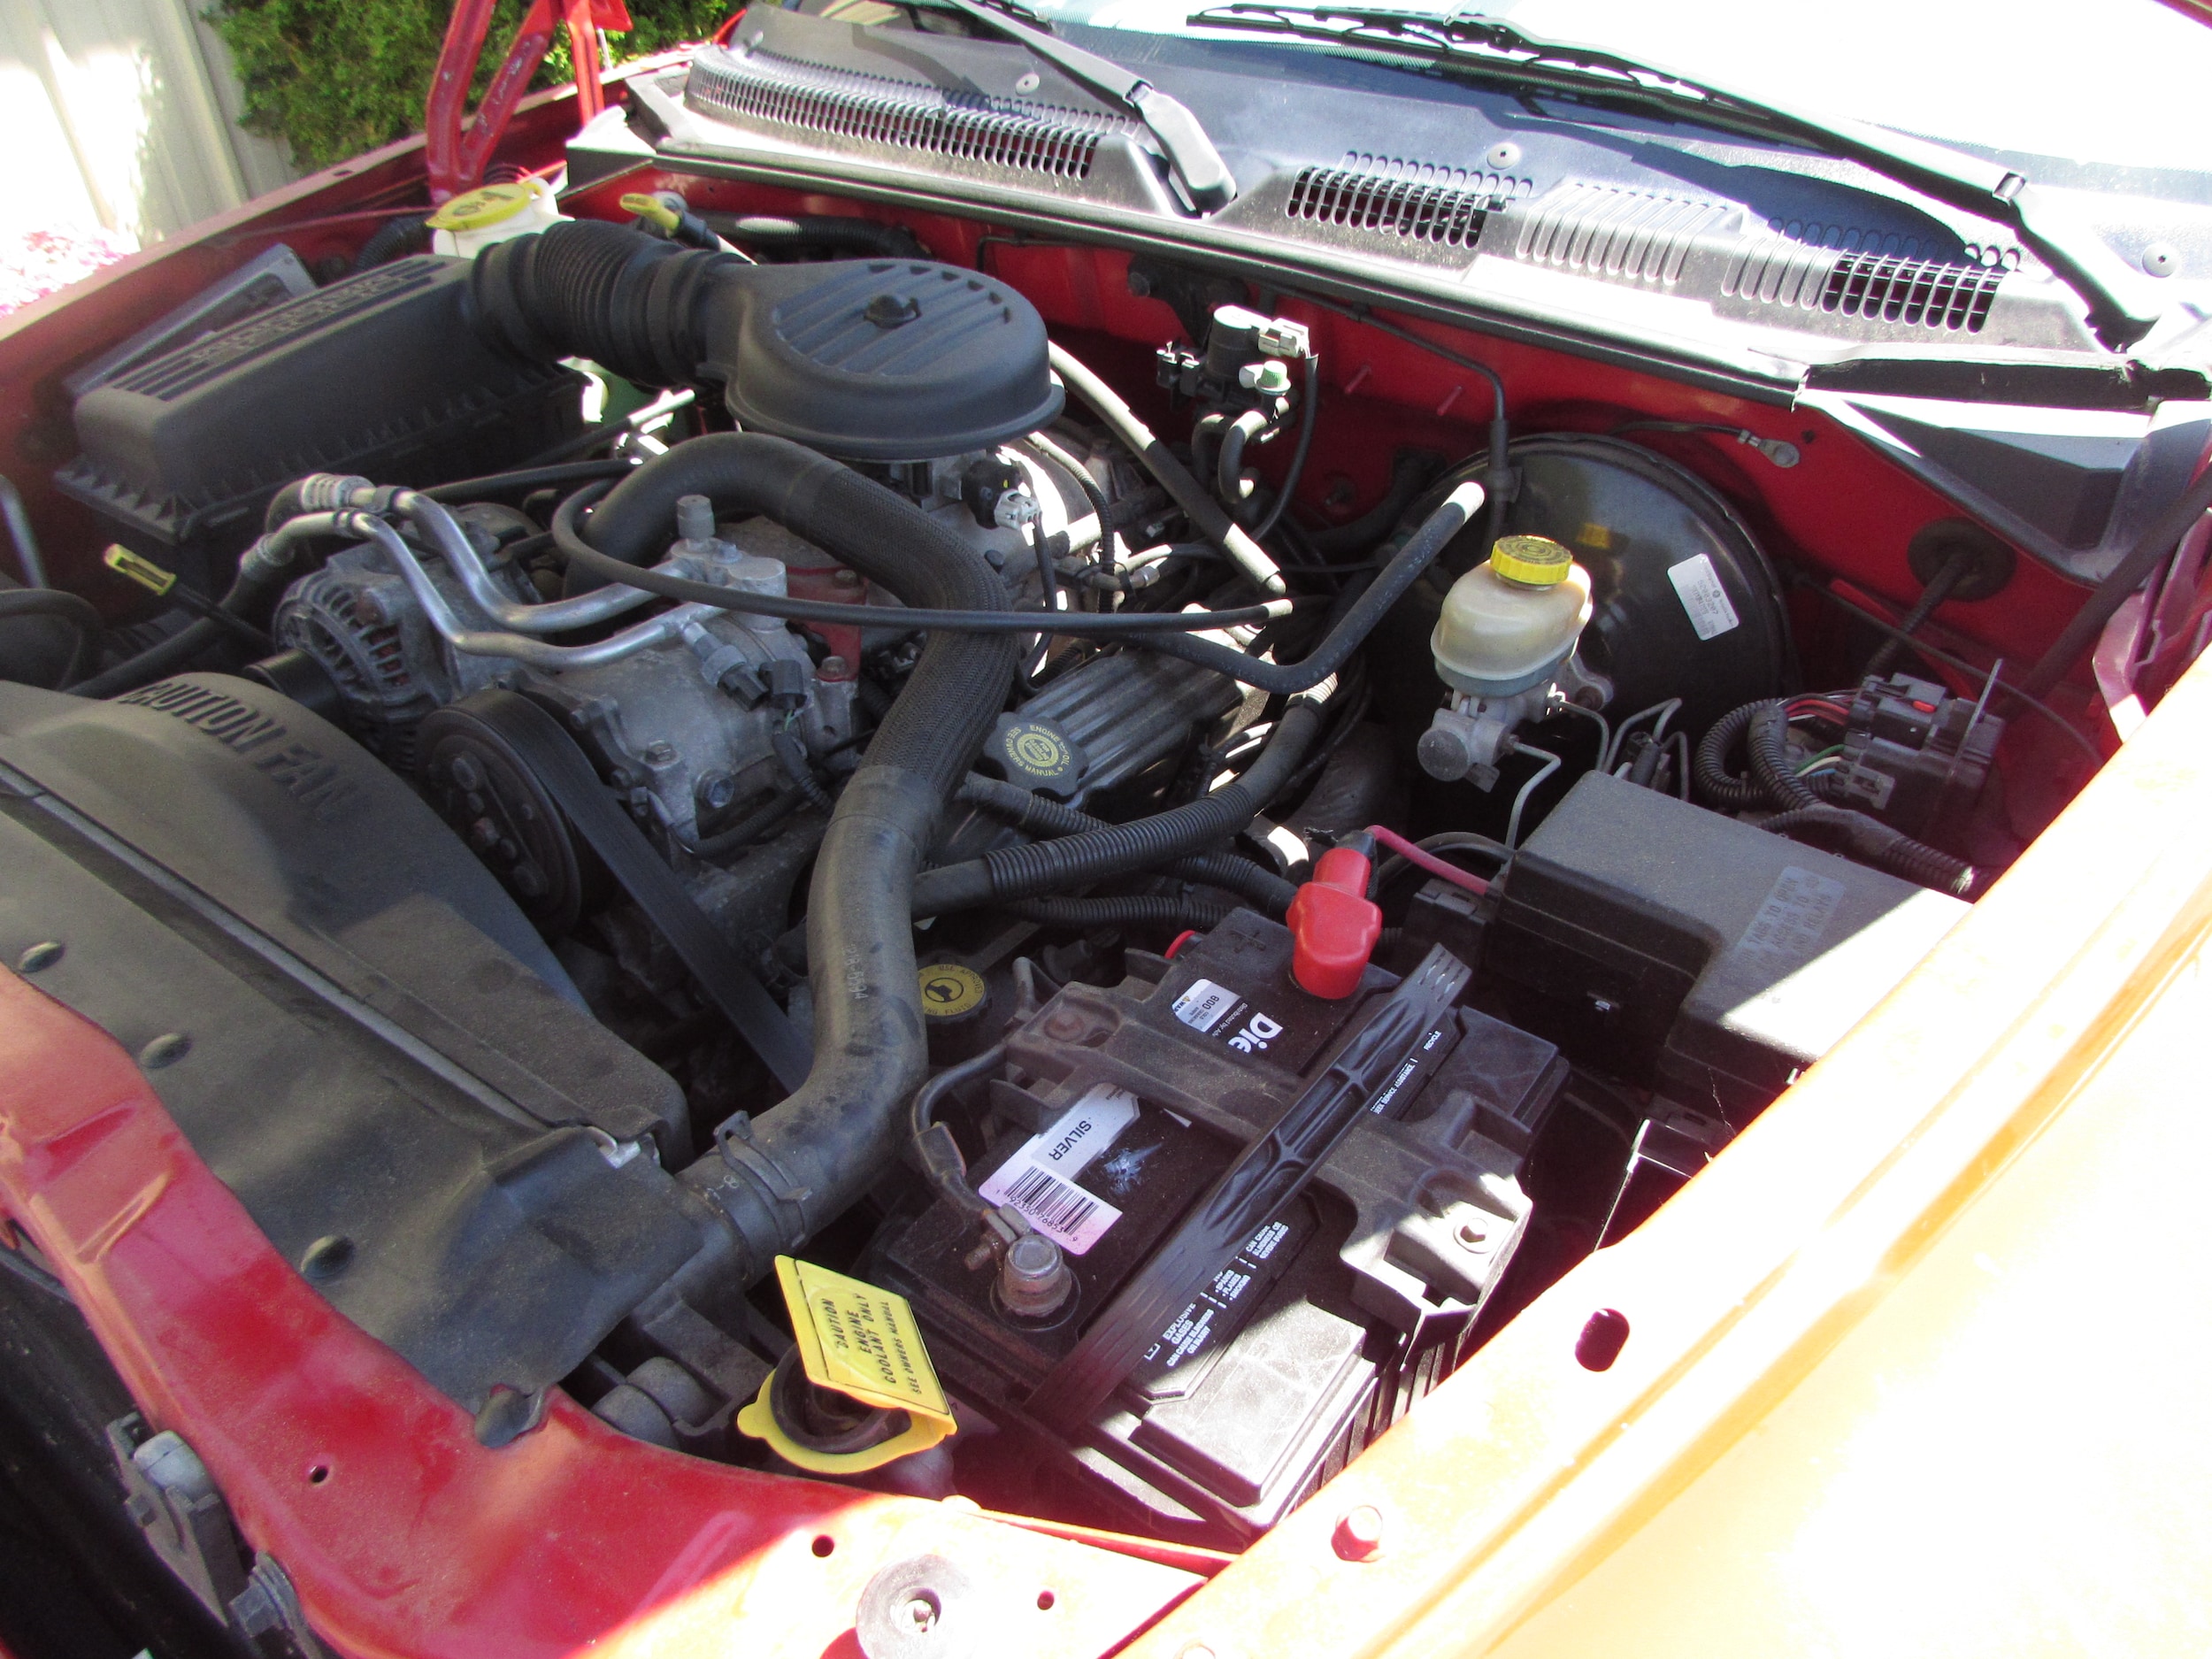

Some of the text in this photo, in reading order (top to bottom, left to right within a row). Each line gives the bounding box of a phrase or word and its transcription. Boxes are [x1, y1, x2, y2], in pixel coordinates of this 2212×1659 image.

[118, 681, 373, 818] CAUTION FAN
[1007, 726, 1021, 739] SEE
[1025, 764, 1059, 776] MANUAL
[1029, 725, 1070, 765] ENGINE OIL
[1763, 903, 1781, 918] TO
[1201, 995, 1220, 1010] 800
[1422, 1030, 1441, 1050] RECYCLE
[1048, 1119, 1092, 1161] SILVER
[1009, 1196, 1036, 1216] 92350
[1036, 1213, 1064, 1233] 76853
[1252, 1228, 1275, 1256] BLINDNESS
[1215, 1268, 1234, 1289] SPARKS
[1223, 1273, 1241, 1294] FLAMES
[821, 1298, 849, 1350] CAUTION
[846, 1310, 872, 1355] ENGINE
[879, 1301, 900, 1335] MANUAL
[1162, 1302, 1195, 1340] EXPLOSIVE
[1170, 1317, 1194, 1345] GASES
[855, 1293, 897, 1384] COOLANT ONLY
[1165, 1308, 1214, 1366] CAN CAUSE BLINDNESS
[1187, 1343, 1197, 1354] OR
[907, 1374, 922, 1394] SEE
